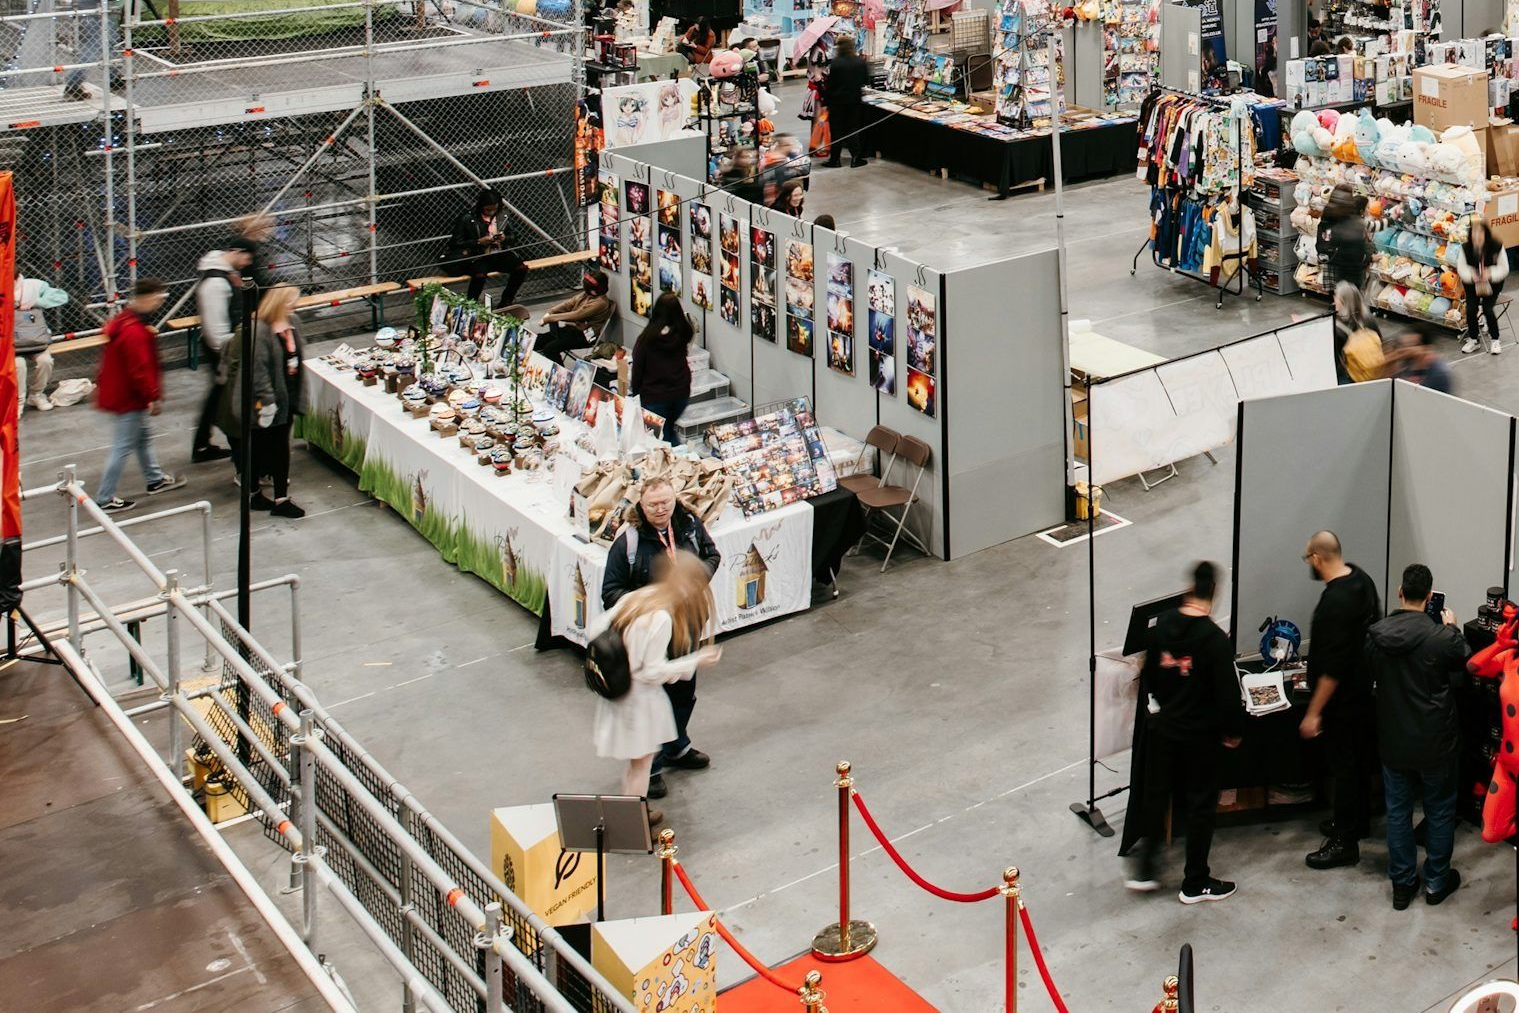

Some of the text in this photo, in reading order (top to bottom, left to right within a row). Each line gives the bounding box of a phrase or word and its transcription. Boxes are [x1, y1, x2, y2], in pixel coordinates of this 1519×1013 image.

[1418, 94, 1447, 108] FRAGILE
[544, 876, 598, 917] VEGAN FRIENDLY
